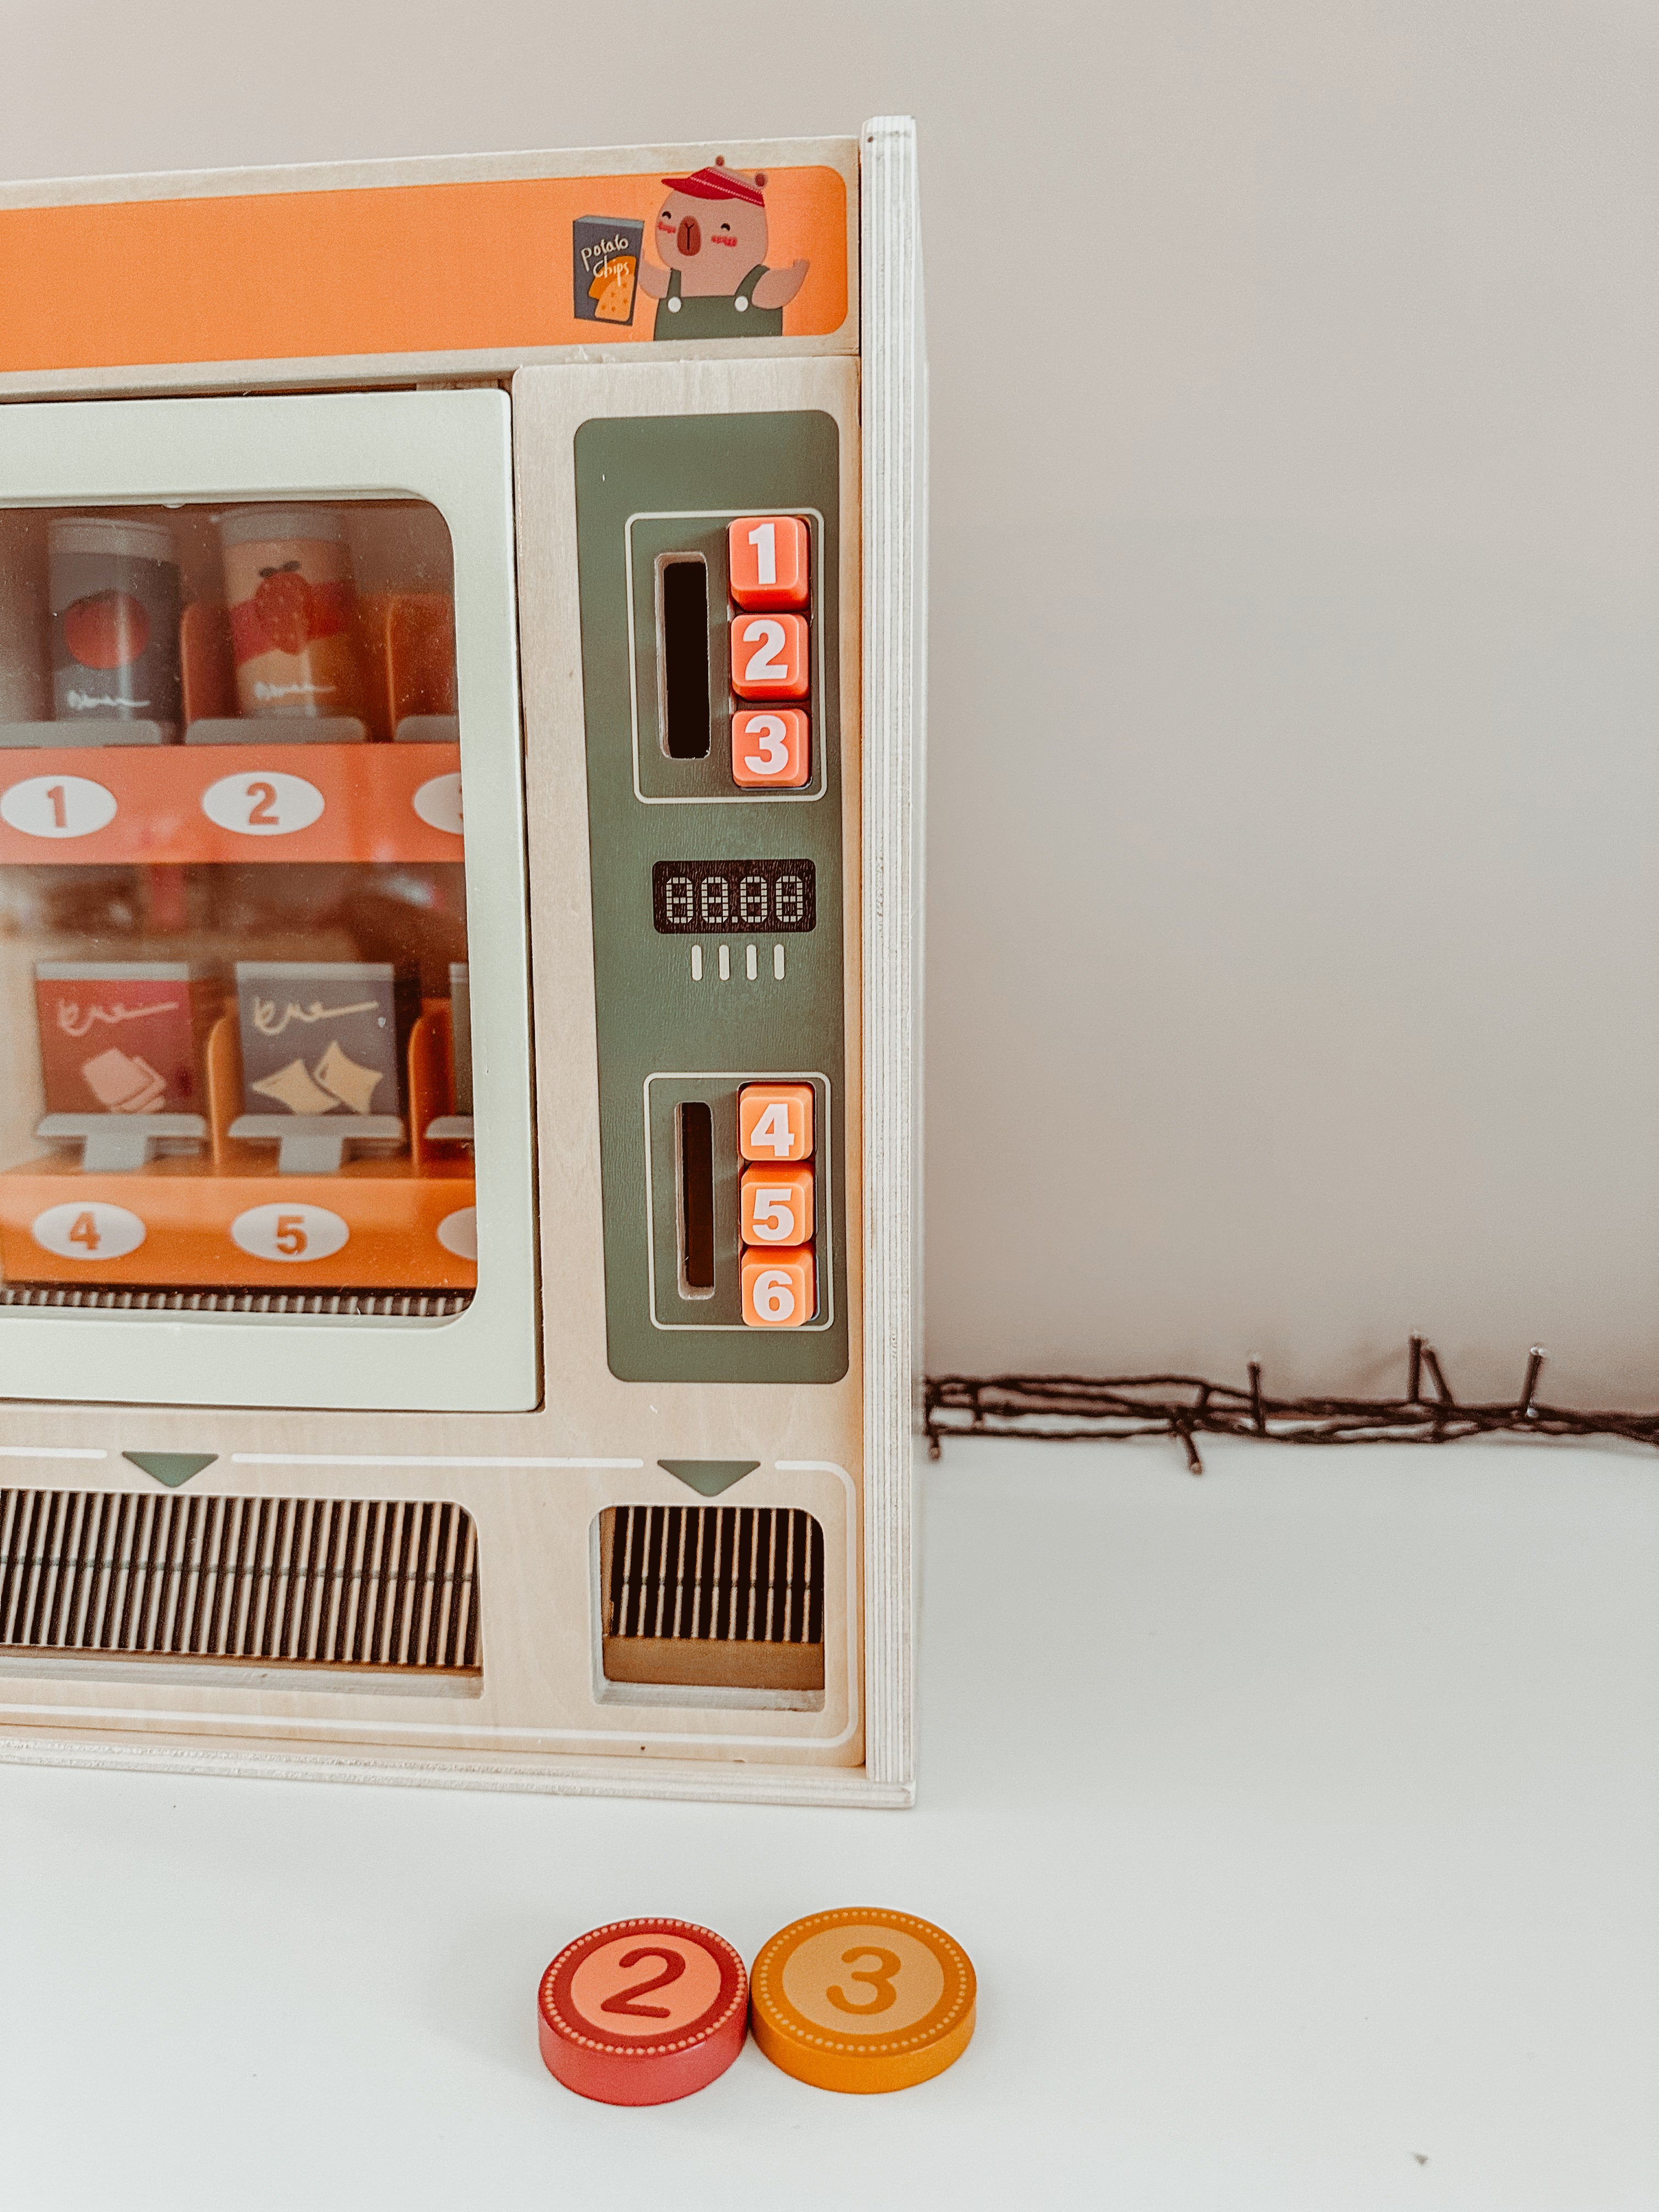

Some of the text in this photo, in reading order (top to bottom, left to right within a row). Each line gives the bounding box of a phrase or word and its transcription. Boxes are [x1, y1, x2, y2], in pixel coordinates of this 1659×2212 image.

[748, 523, 776, 585] 1
[743, 619, 788, 681] 2
[744, 715, 789, 775] 3
[46, 785, 67, 828] 1
[246, 781, 279, 825] 2
[750, 1103, 795, 1157] 4
[69, 1211, 101, 1250] 4
[276, 1216, 308, 1255] 5
[752, 1188, 795, 1241] 5
[752, 1269, 795, 1322] 6
[600, 1946, 686, 2019] 2
[826, 1945, 902, 2016] 3
